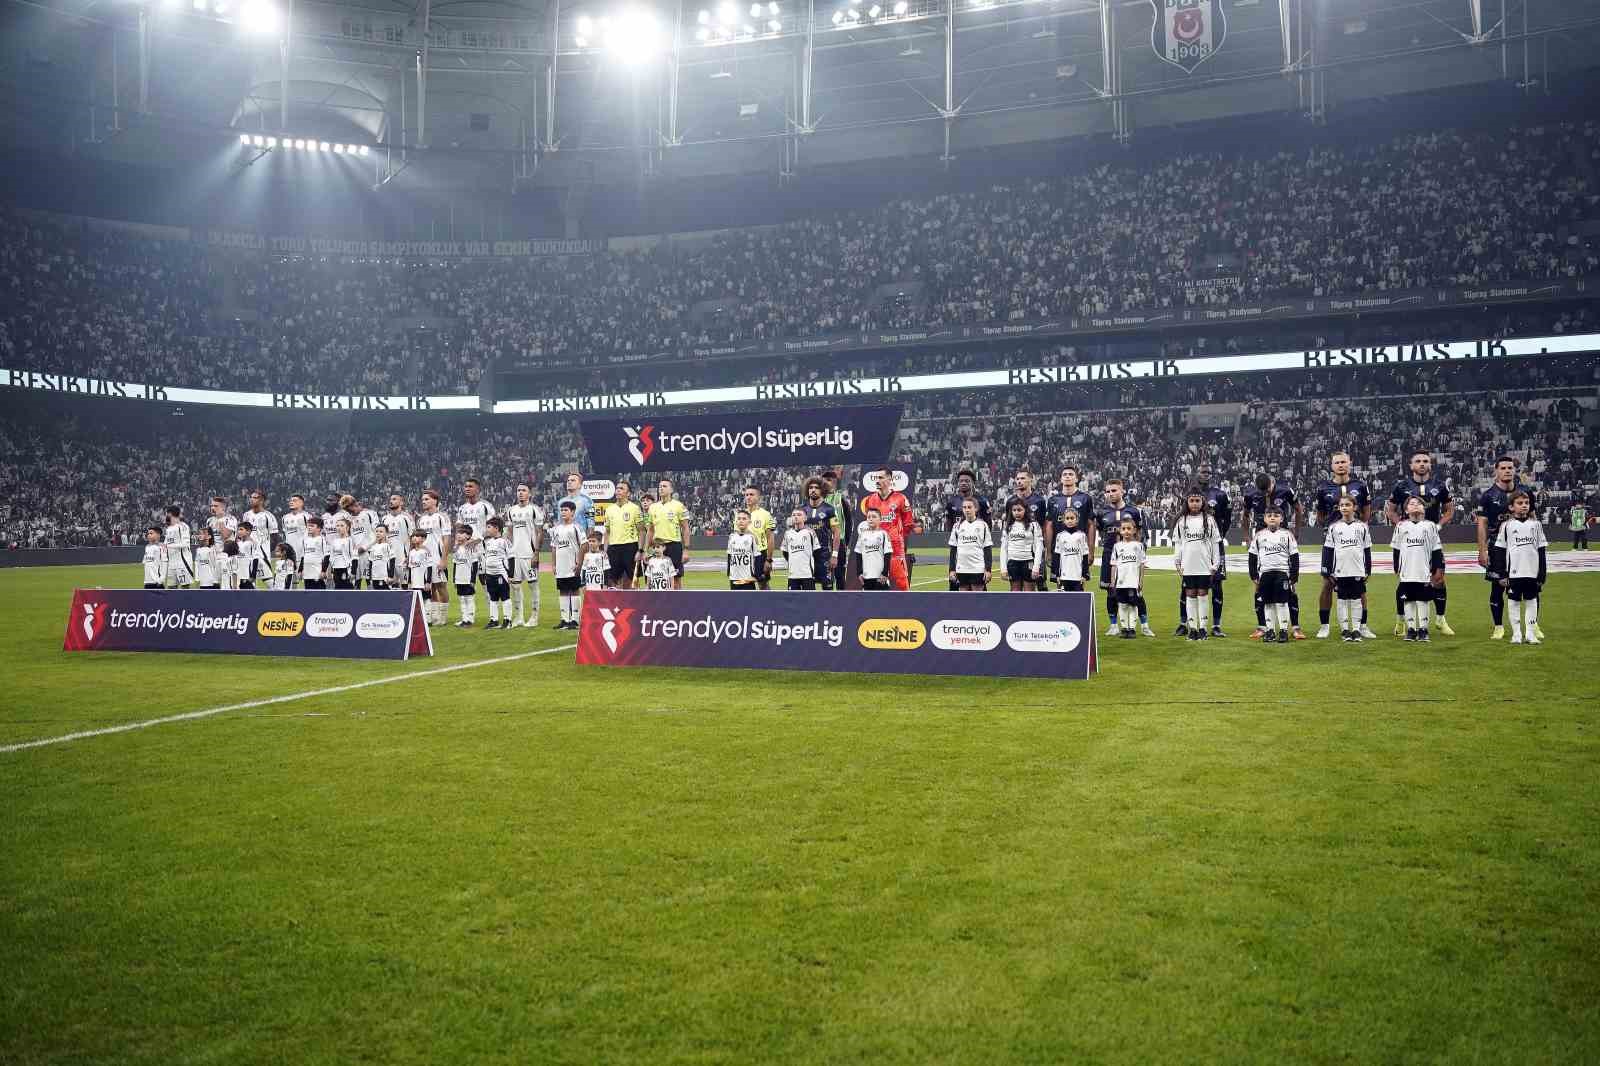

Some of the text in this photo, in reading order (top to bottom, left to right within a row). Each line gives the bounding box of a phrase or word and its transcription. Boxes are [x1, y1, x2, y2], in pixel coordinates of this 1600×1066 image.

[659, 425, 853, 454] trendyol SüperLig
[110, 609, 249, 635] trendyol SüperLig
[314, 616, 347, 626] trendyol
[640, 614, 843, 647] trendyol SüperLig
[943, 624, 991, 636] trendyol
[950, 637, 982, 645] yemek
